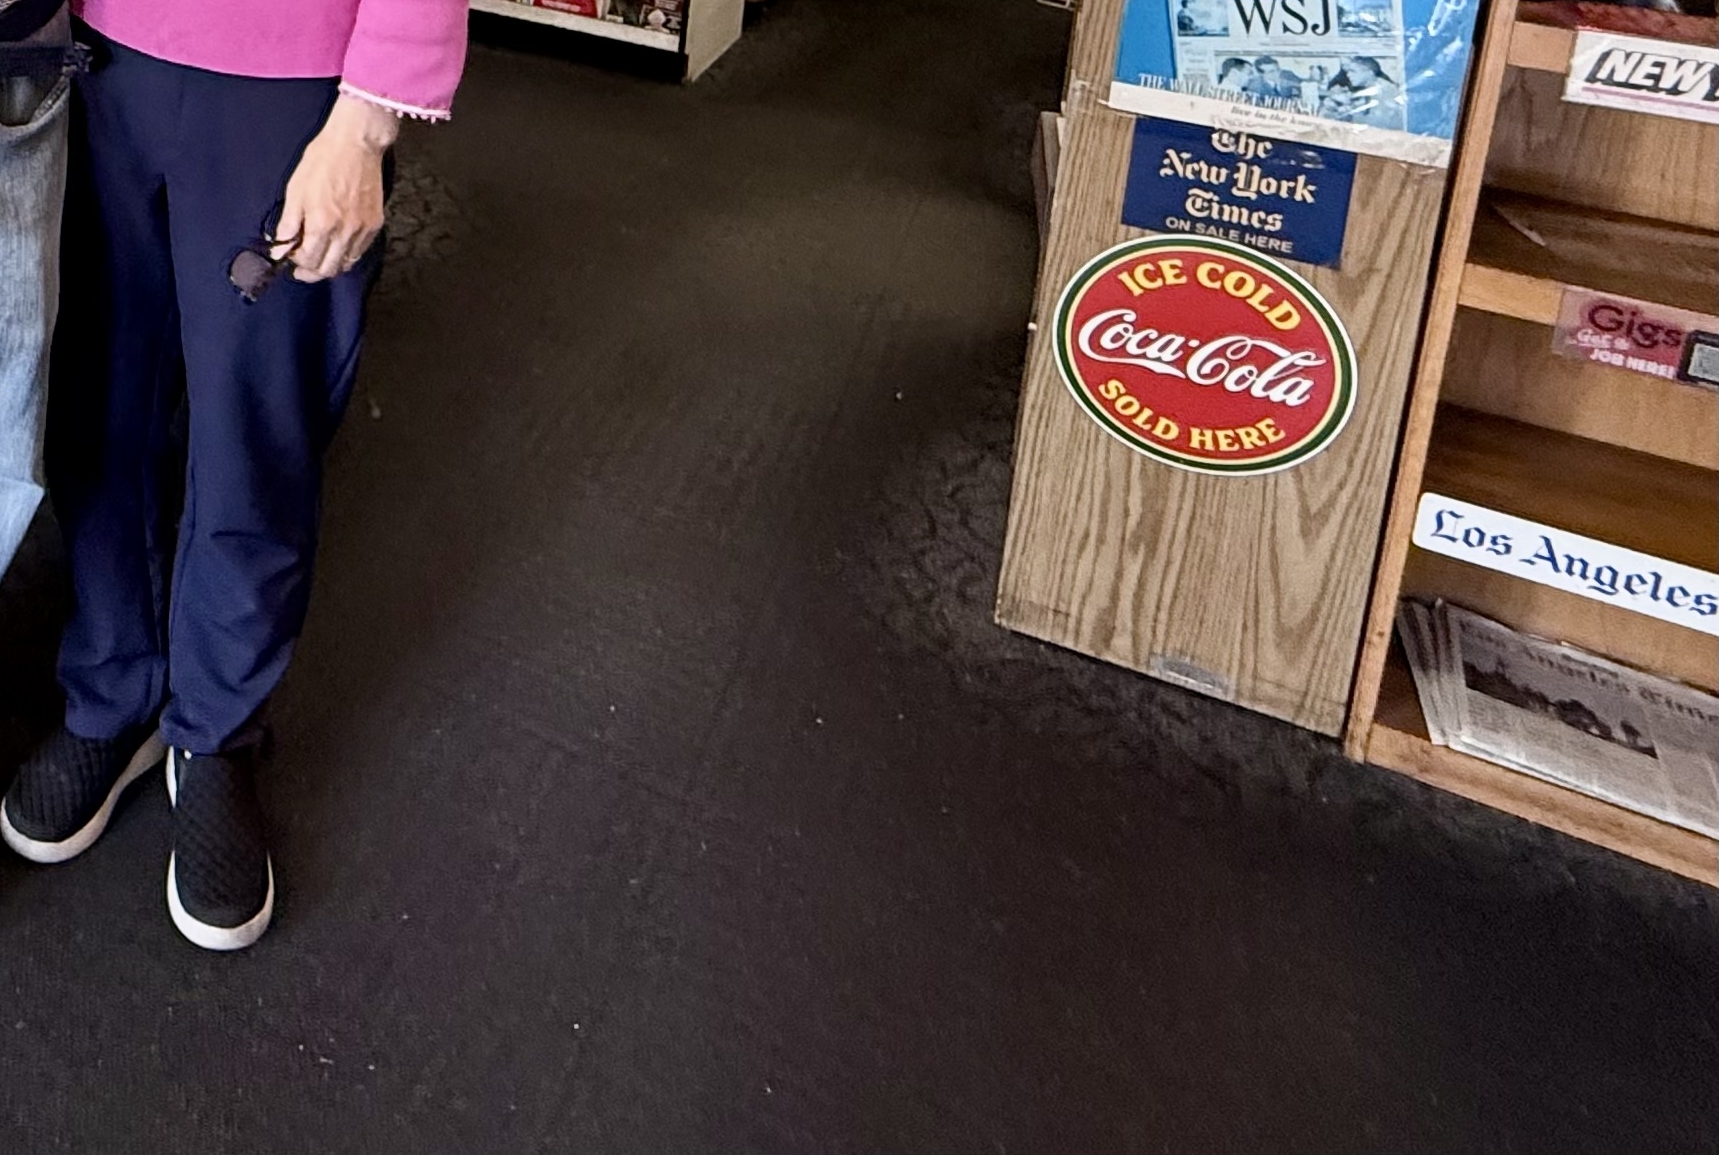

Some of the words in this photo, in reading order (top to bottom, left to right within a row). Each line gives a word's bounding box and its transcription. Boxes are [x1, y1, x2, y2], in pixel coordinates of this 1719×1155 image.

[1138, 73, 1166, 90] THE
[1169, 75, 1205, 97] WALL
[1207, 81, 1263, 107] STREET
[1585, 47, 1712, 96] NEW
[1210, 128, 1273, 160] The
[1158, 148, 1230, 186] New
[1232, 160, 1317, 204] York
[1185, 188, 1284, 232] Times
[1165, 216, 1191, 233] ON
[1194, 222, 1240, 242] SALE
[1243, 234, 1293, 254] HERE
[1117, 258, 1187, 297] ICE
[1195, 261, 1302, 331] COLD
[1576, 329, 1613, 348] Get
[1586, 303, 1683, 350] Gigs
[1590, 348, 1624, 368] JOB
[1626, 355, 1679, 380] HERE!
[1097, 378, 1180, 441] SOLD
[1189, 417, 1286, 453] HERE
[1430, 508, 1514, 557] Los
[1518, 534, 1718, 618] Angeles
